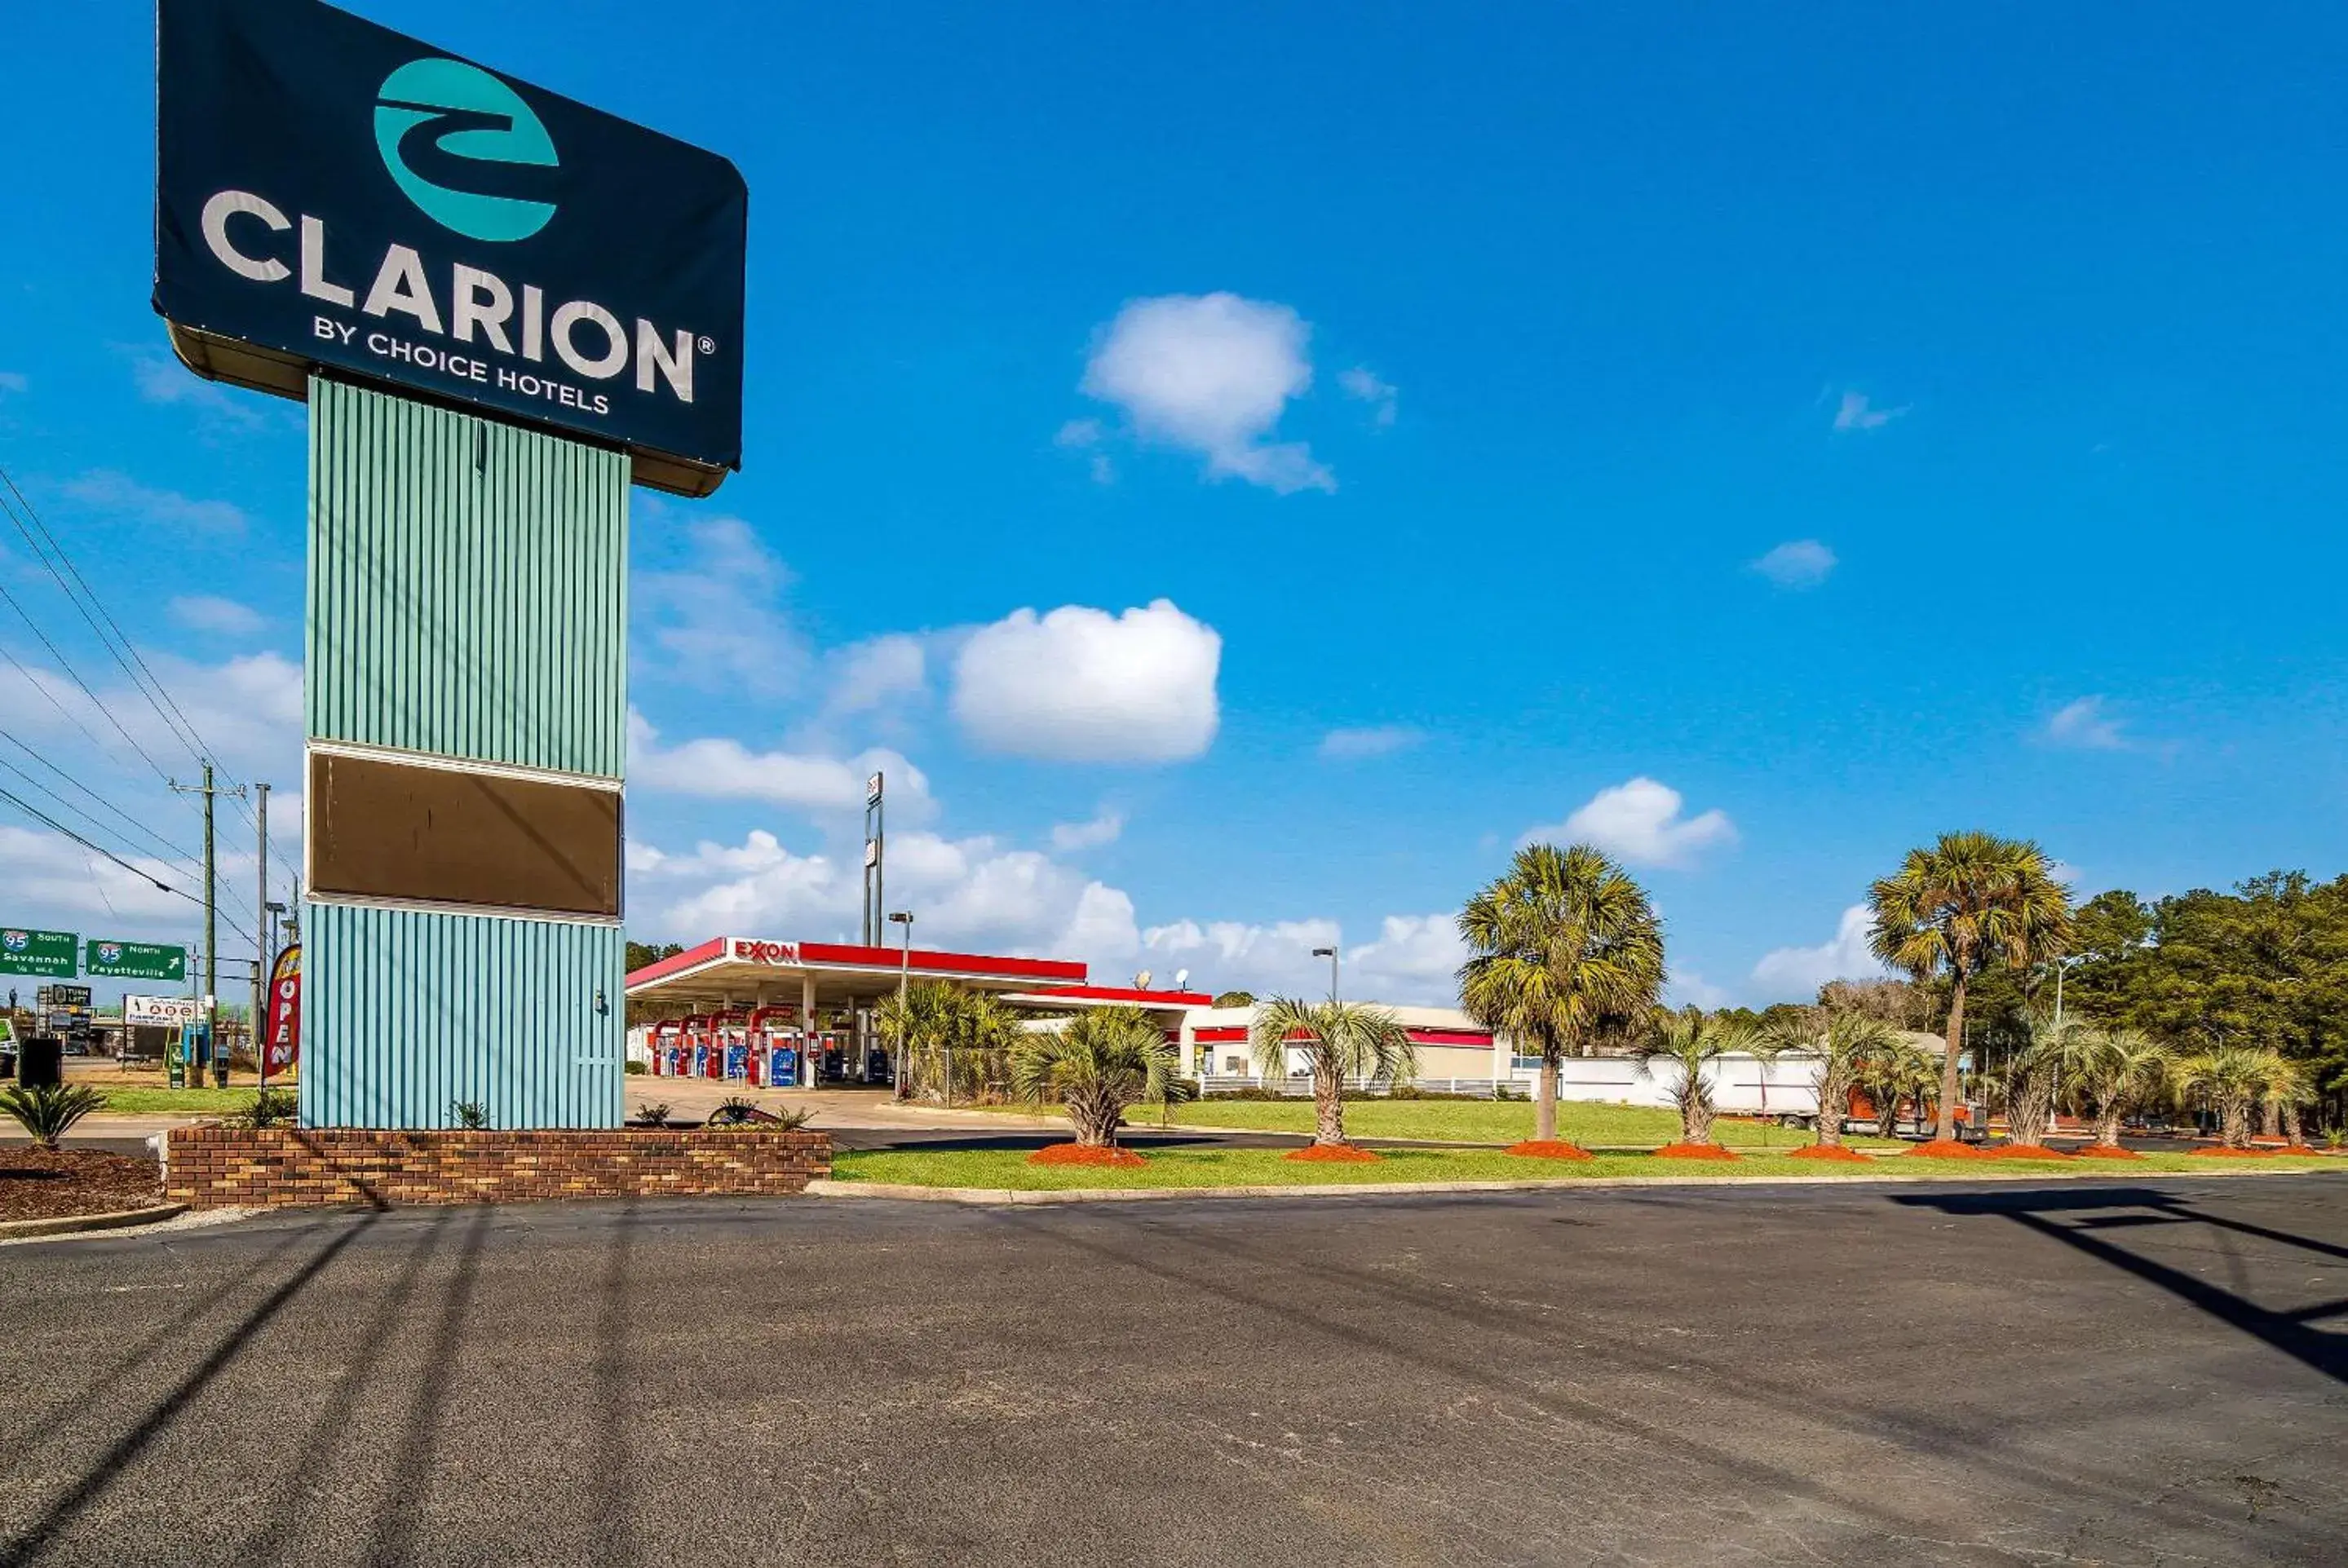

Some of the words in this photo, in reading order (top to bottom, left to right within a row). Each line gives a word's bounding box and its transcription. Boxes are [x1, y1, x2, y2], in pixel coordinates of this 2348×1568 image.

[314, 316, 356, 346] BY
[368, 333, 487, 382] CHOICE
[497, 368, 608, 414] HOTELS
[6, 935, 26, 947] 95
[37, 934, 69, 943] SOUTH
[3, 952, 69, 965] Savannah
[99, 948, 119, 961] 95
[129, 946, 161, 955] NORTH
[735, 940, 795, 964] EXXON
[91, 965, 165, 977] Fayetteville
[271, 980, 295, 1065] OPEN
